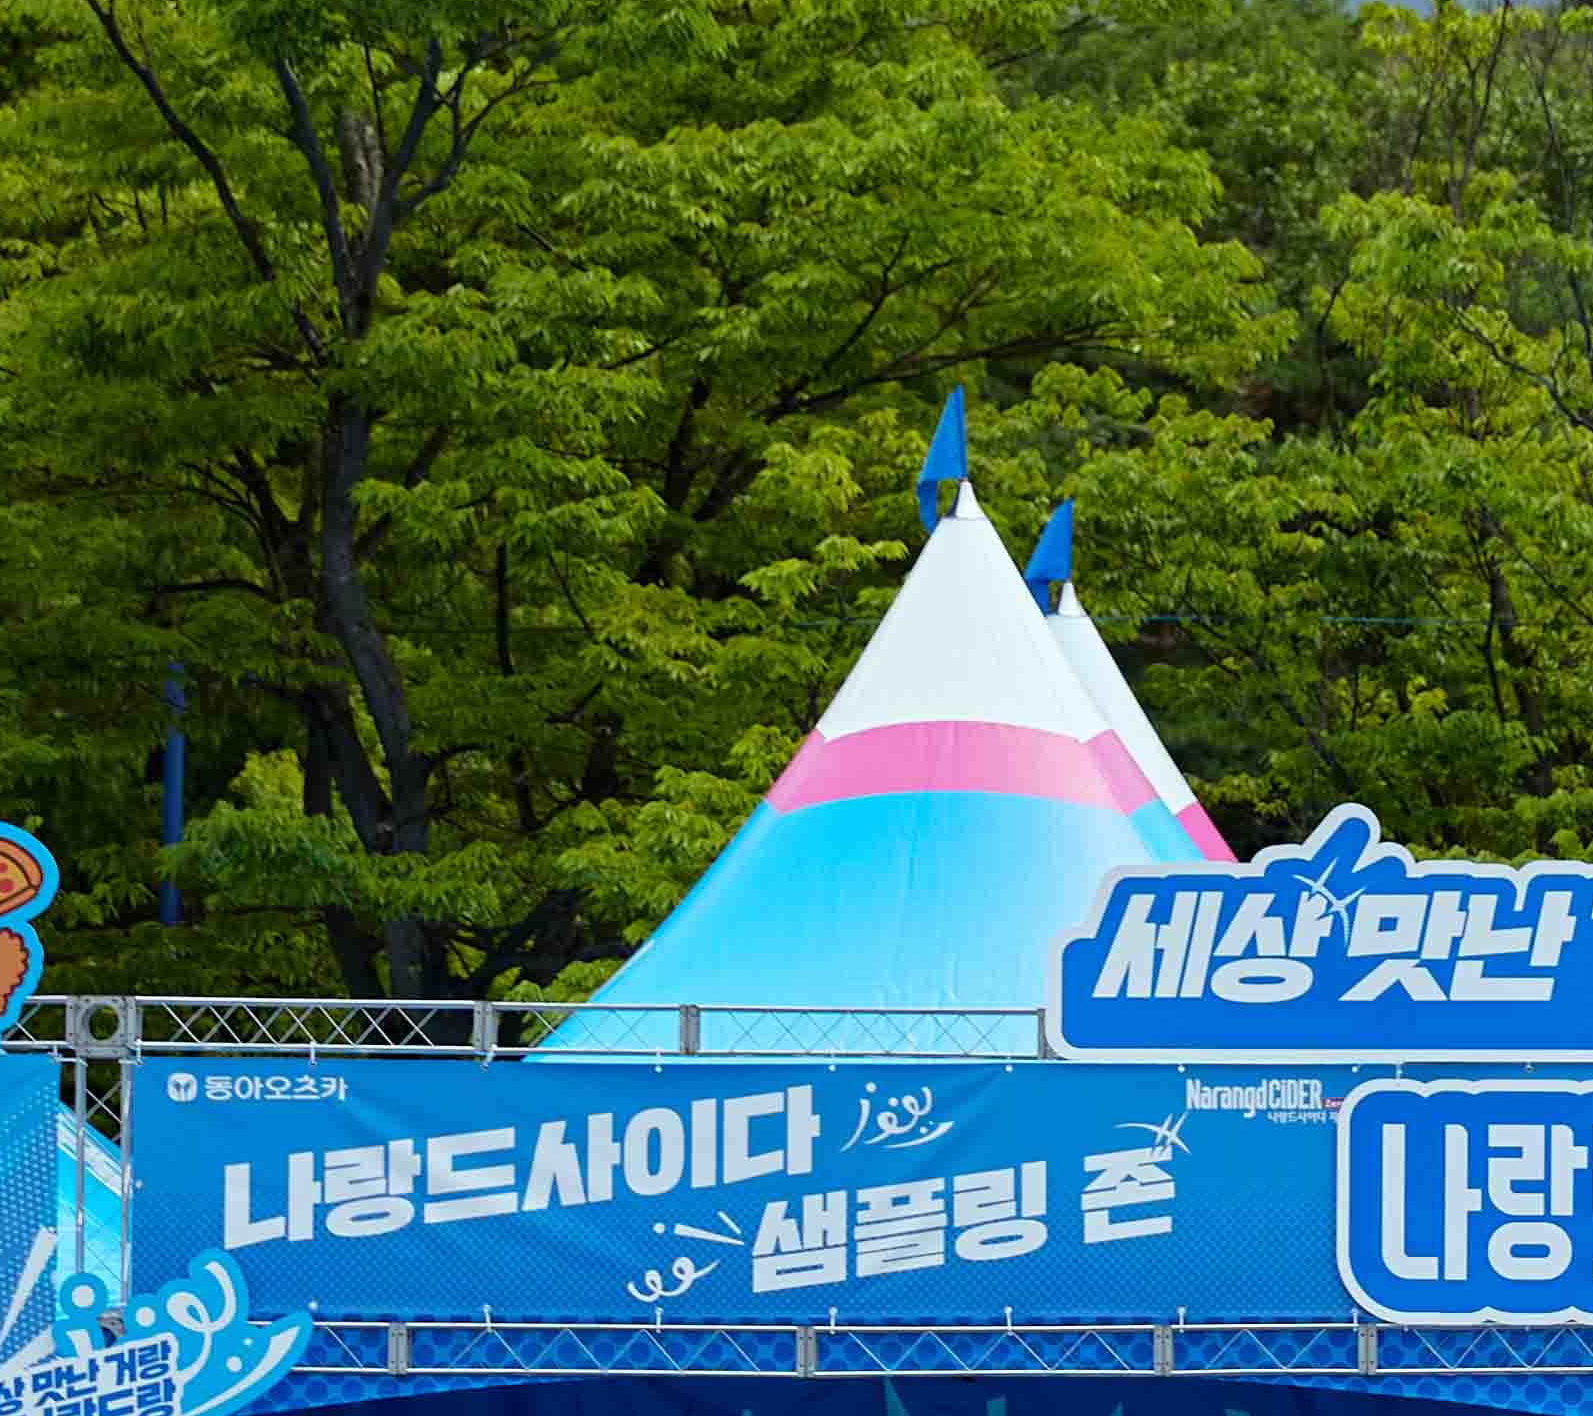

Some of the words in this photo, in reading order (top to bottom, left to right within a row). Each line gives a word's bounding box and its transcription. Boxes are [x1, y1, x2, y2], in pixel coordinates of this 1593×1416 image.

[1093, 889, 1331, 1002] 세상
[1342, 889, 1574, 1002] 맛난
[204, 1073, 348, 1103] 동아오츠카
[224, 1084, 821, 1249] 나랑드사이다
[751, 1159, 1046, 1294] 샘플링
[1083, 1142, 1175, 1244] 존
[36, 1356, 98, 1406] 맛난
[107, 1341, 171, 1384] 거랑
